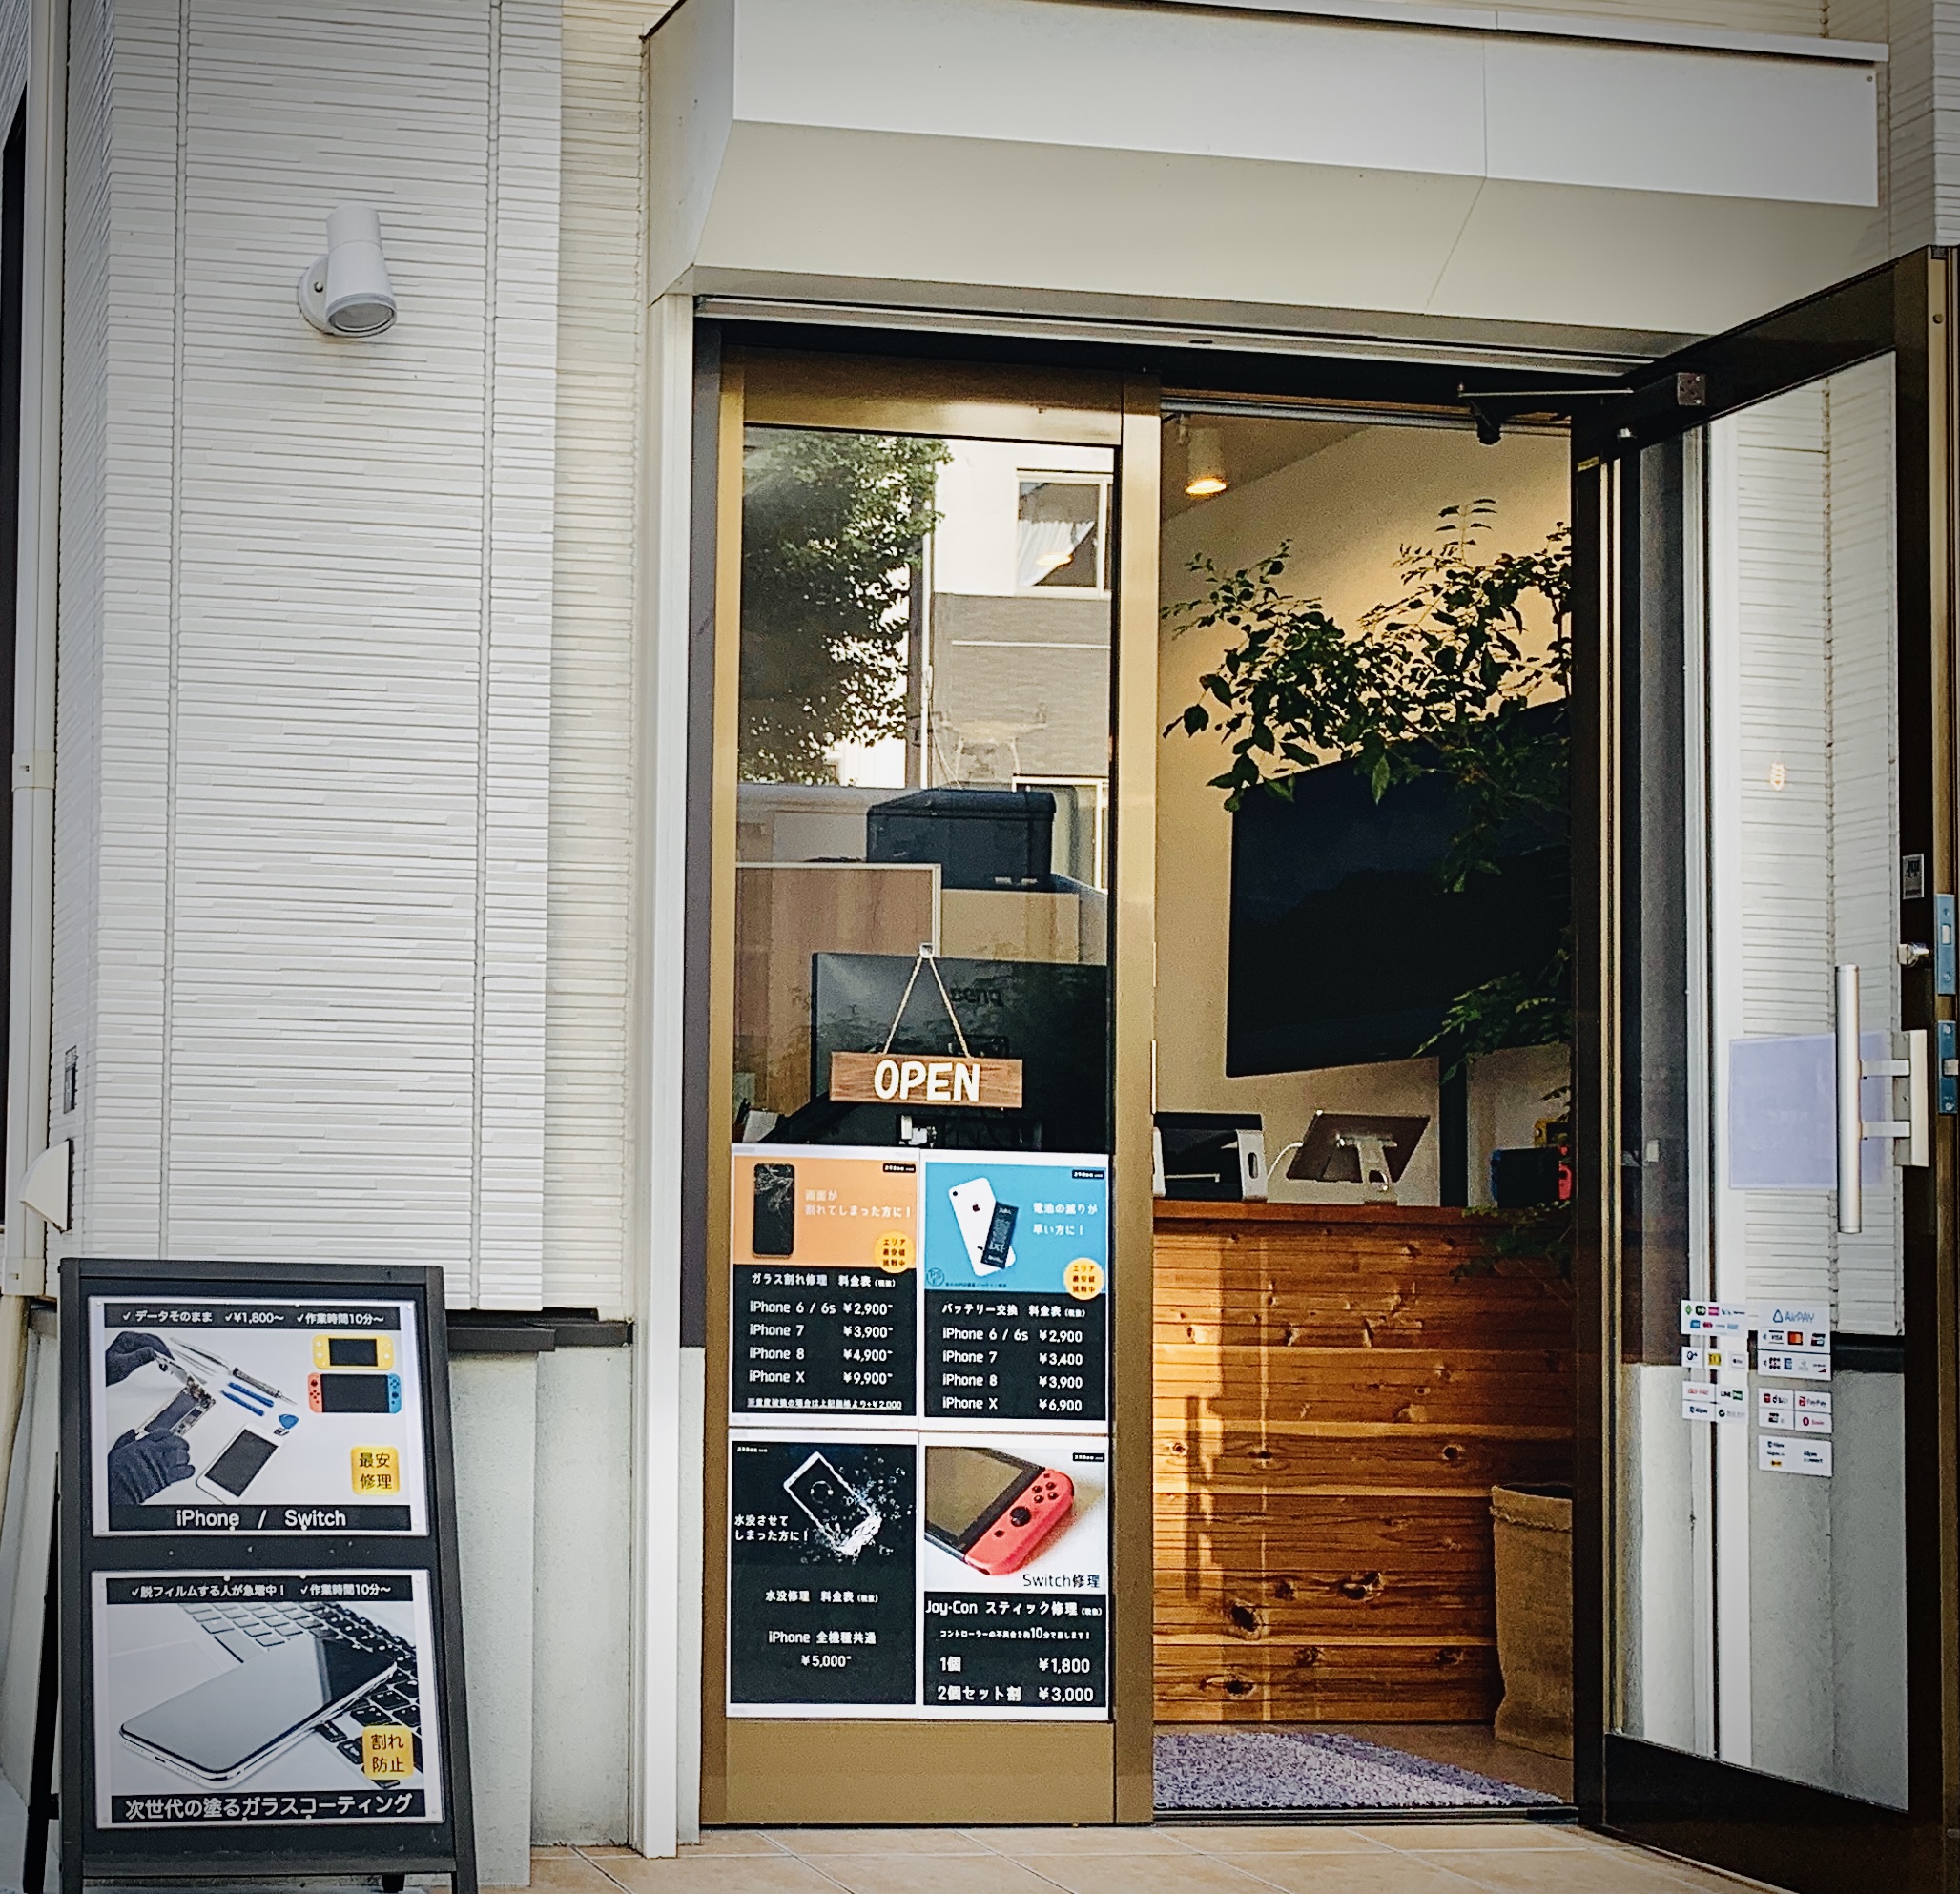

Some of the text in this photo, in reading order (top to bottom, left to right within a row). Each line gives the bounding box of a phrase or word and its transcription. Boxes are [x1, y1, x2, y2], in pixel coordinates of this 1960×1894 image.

[874, 1059, 980, 1102] OPEN
[752, 1273, 828, 1287] ガラス割れ修理
[750, 1300, 791, 1313] iPhone
[795, 1302, 804, 1313] 6
[820, 1302, 836, 1314] 6s
[941, 1303, 1019, 1317] バッテリー交換
[134, 1309, 213, 1323] データそのまま
[750, 1324, 791, 1336] iPhone
[795, 1325, 805, 1336] 7
[942, 1327, 983, 1340] iPhone
[988, 1328, 998, 1340] 6
[1014, 1328, 1028, 1342] 6s
[750, 1347, 791, 1360] iPhone
[795, 1348, 805, 1360] 8
[942, 1350, 983, 1363] iPhone
[988, 1351, 998, 1364] 7
[749, 1369, 791, 1383] iPhone
[795, 1371, 805, 1383] X
[942, 1373, 983, 1387] iPhone
[989, 1374, 998, 1387] 8
[942, 1396, 983, 1410] iPhone
[988, 1397, 998, 1410] X
[359, 1452, 390, 1469] 最安
[360, 1473, 393, 1490] 修理
[176, 1509, 347, 1529] iPhone / Switch
[734, 1514, 789, 1527] 水没させて
[985, 1601, 1078, 1616] スティック修理
[769, 1631, 811, 1644] iPhone
[939, 1656, 1090, 1674] 1個 ¥1,800
[1038, 1686, 1094, 1703] ¥3,000
[371, 1733, 404, 1751] 割れ
[372, 1756, 405, 1774] 防止
[125, 1793, 413, 1820] 次世代の塗るガラスコーティング
